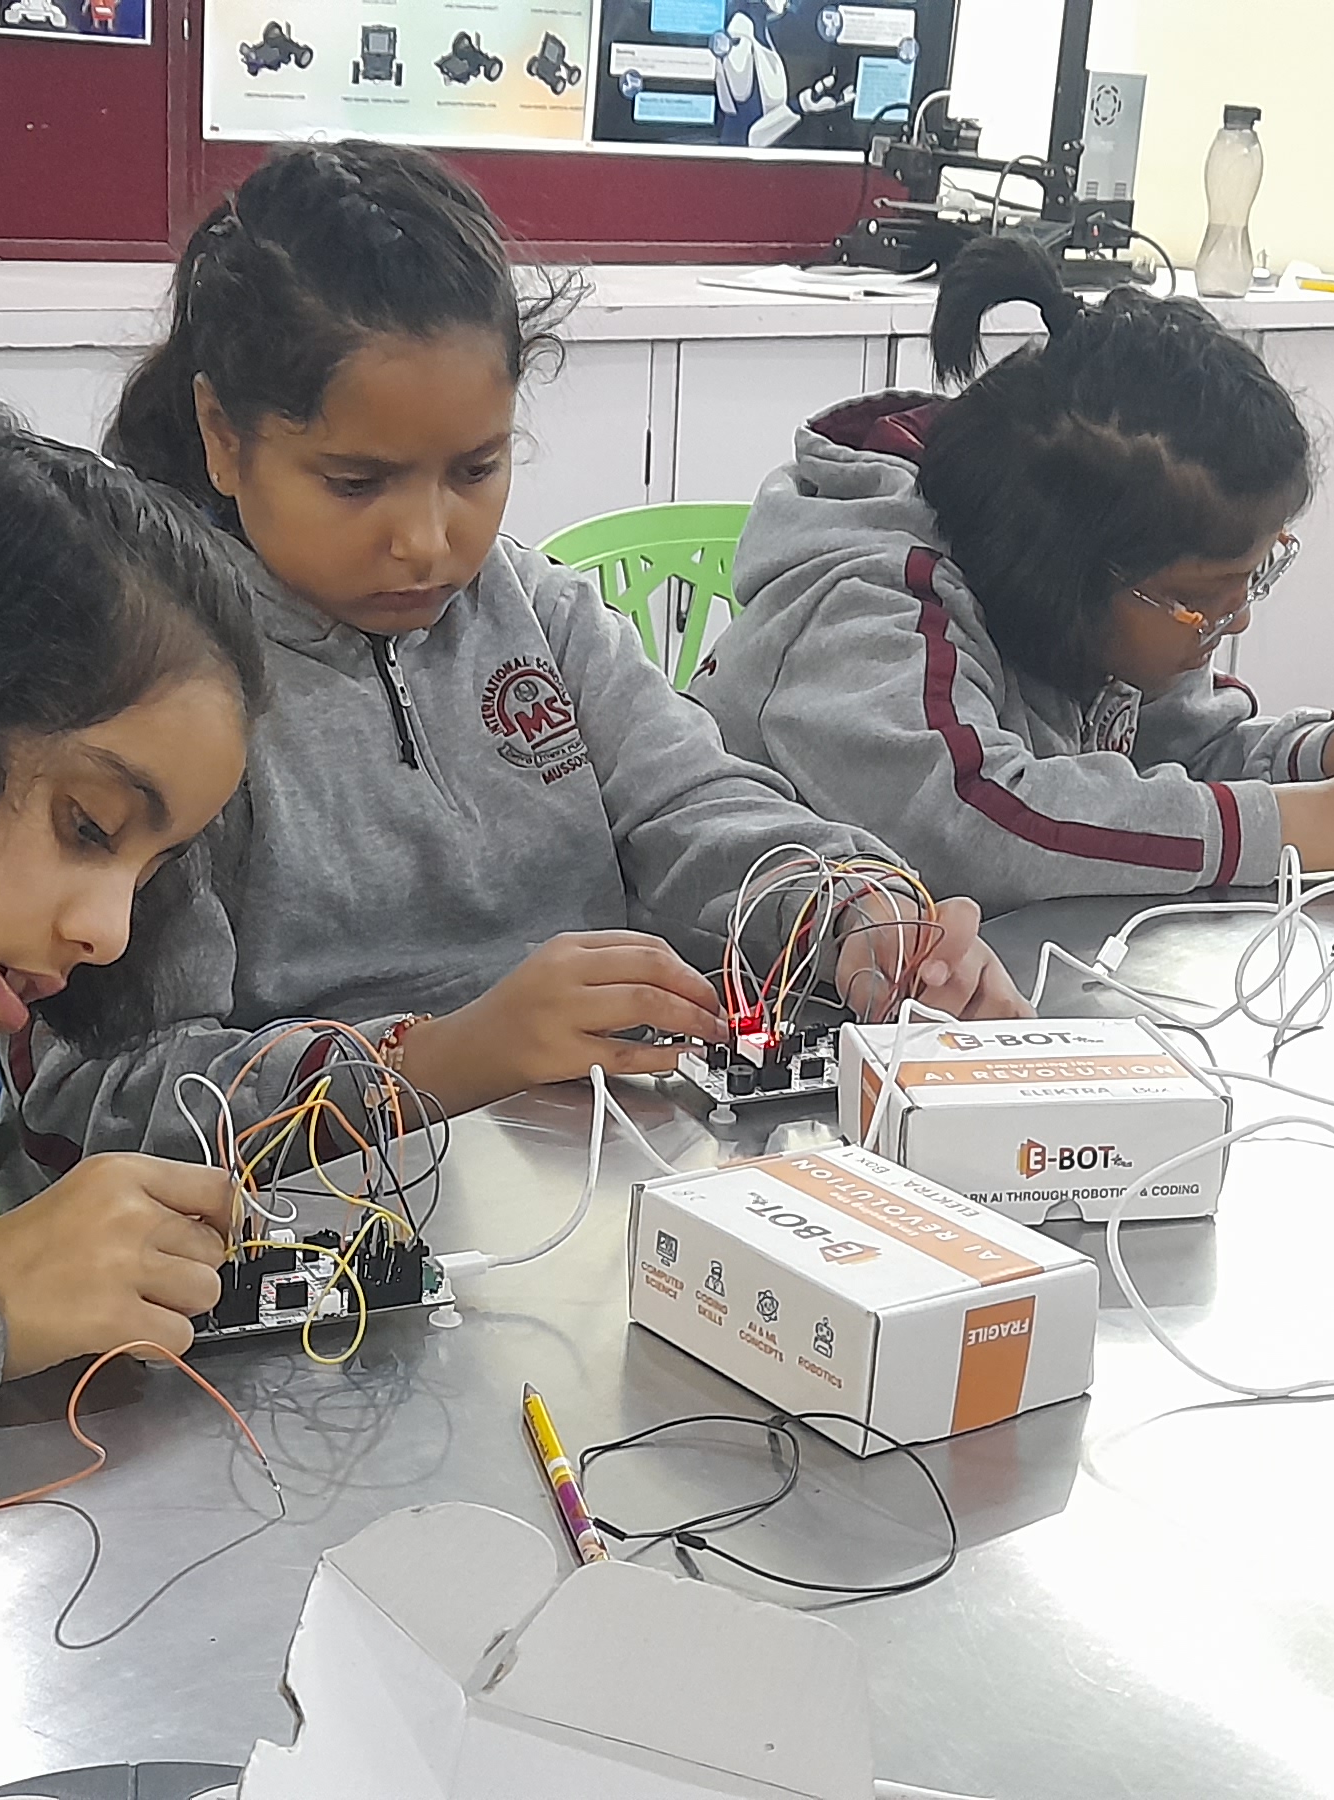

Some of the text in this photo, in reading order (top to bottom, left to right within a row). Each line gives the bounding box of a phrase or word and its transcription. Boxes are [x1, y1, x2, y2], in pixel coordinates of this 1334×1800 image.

[923, 1063, 1177, 1082] AI REVOLUTION
[1019, 1085, 1112, 1098] ELEKTRA
[1023, 1143, 1116, 1174] E-BOT
[905, 1179, 981, 1218] ELEKTRA
[990, 1192, 1003, 1203] AI
[1006, 1189, 1069, 1203] THROUGH
[1151, 1183, 1200, 1197] CODING
[790, 1158, 1003, 1262] AI REVOLUTION
[640, 1260, 685, 1291] COMPUTER
[645, 1274, 678, 1300] SCIENCE
[695, 1290, 728, 1315] CODING
[697, 1304, 723, 1327] SKILLS
[738, 1329, 784, 1363] CONCEPTS
[966, 1317, 1031, 1347] FRAGILE
[797, 1355, 843, 1389] ROBOTICS
